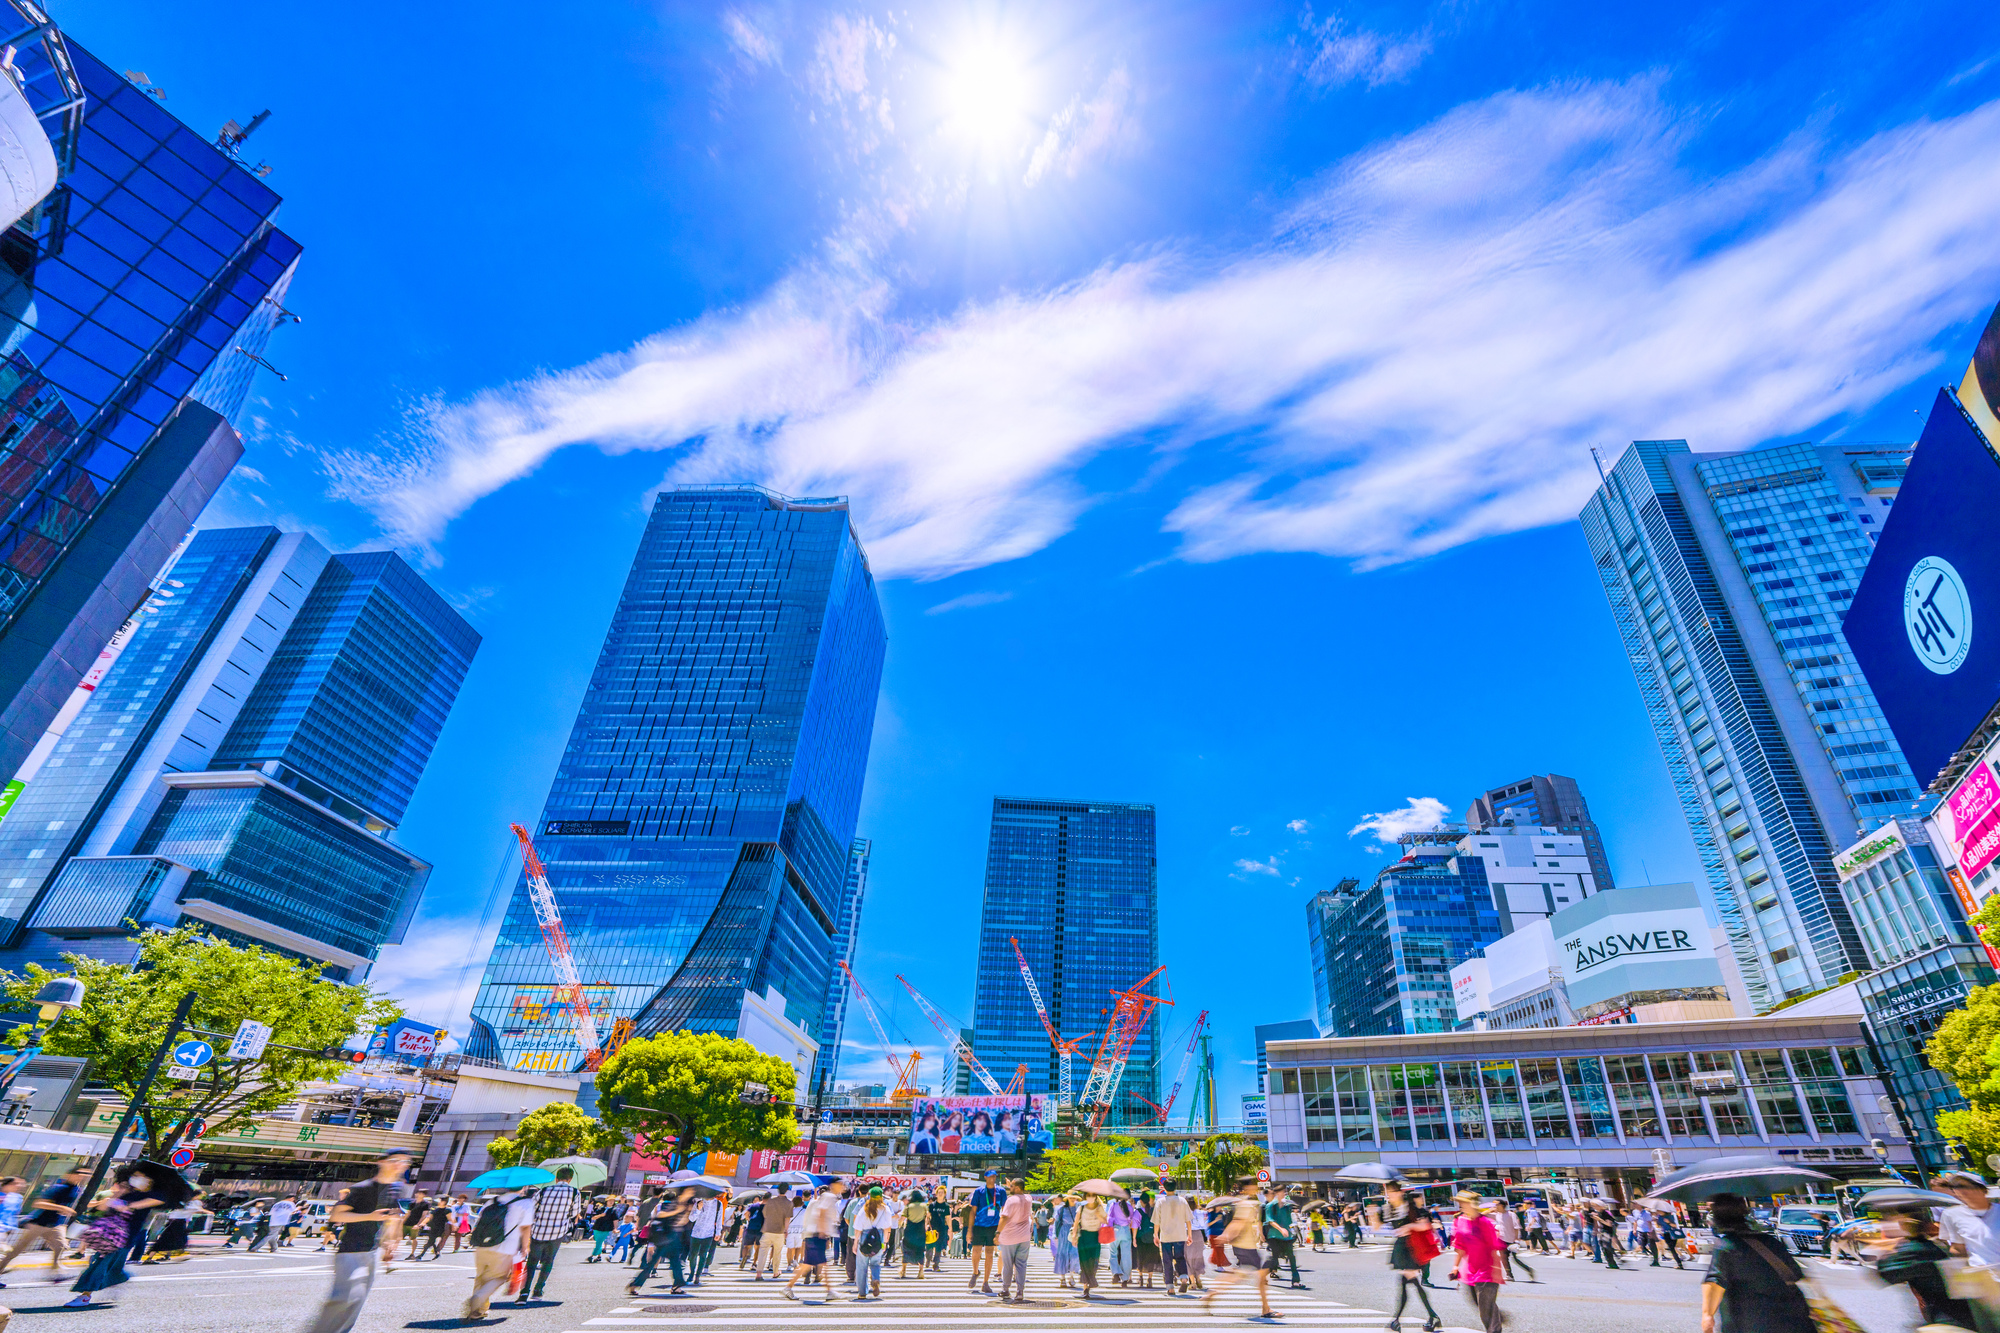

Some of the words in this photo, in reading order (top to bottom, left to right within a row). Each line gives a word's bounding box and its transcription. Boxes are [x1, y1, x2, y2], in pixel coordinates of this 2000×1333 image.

[1912, 559, 1931, 577] GINZA
[1959, 772, 1988, 809] 品川スキン
[1965, 787, 1993, 821] クリニック
[1564, 937, 1582, 952] THE
[1576, 929, 1692, 969] ANSWER
[1875, 1000, 1918, 1020] MARK
[1923, 985, 1961, 1004] CITY
[1891, 986, 1932, 1004] SHIBUYA
[401, 1031, 432, 1044] ファイト
[959, 1141, 1000, 1152] indeed
